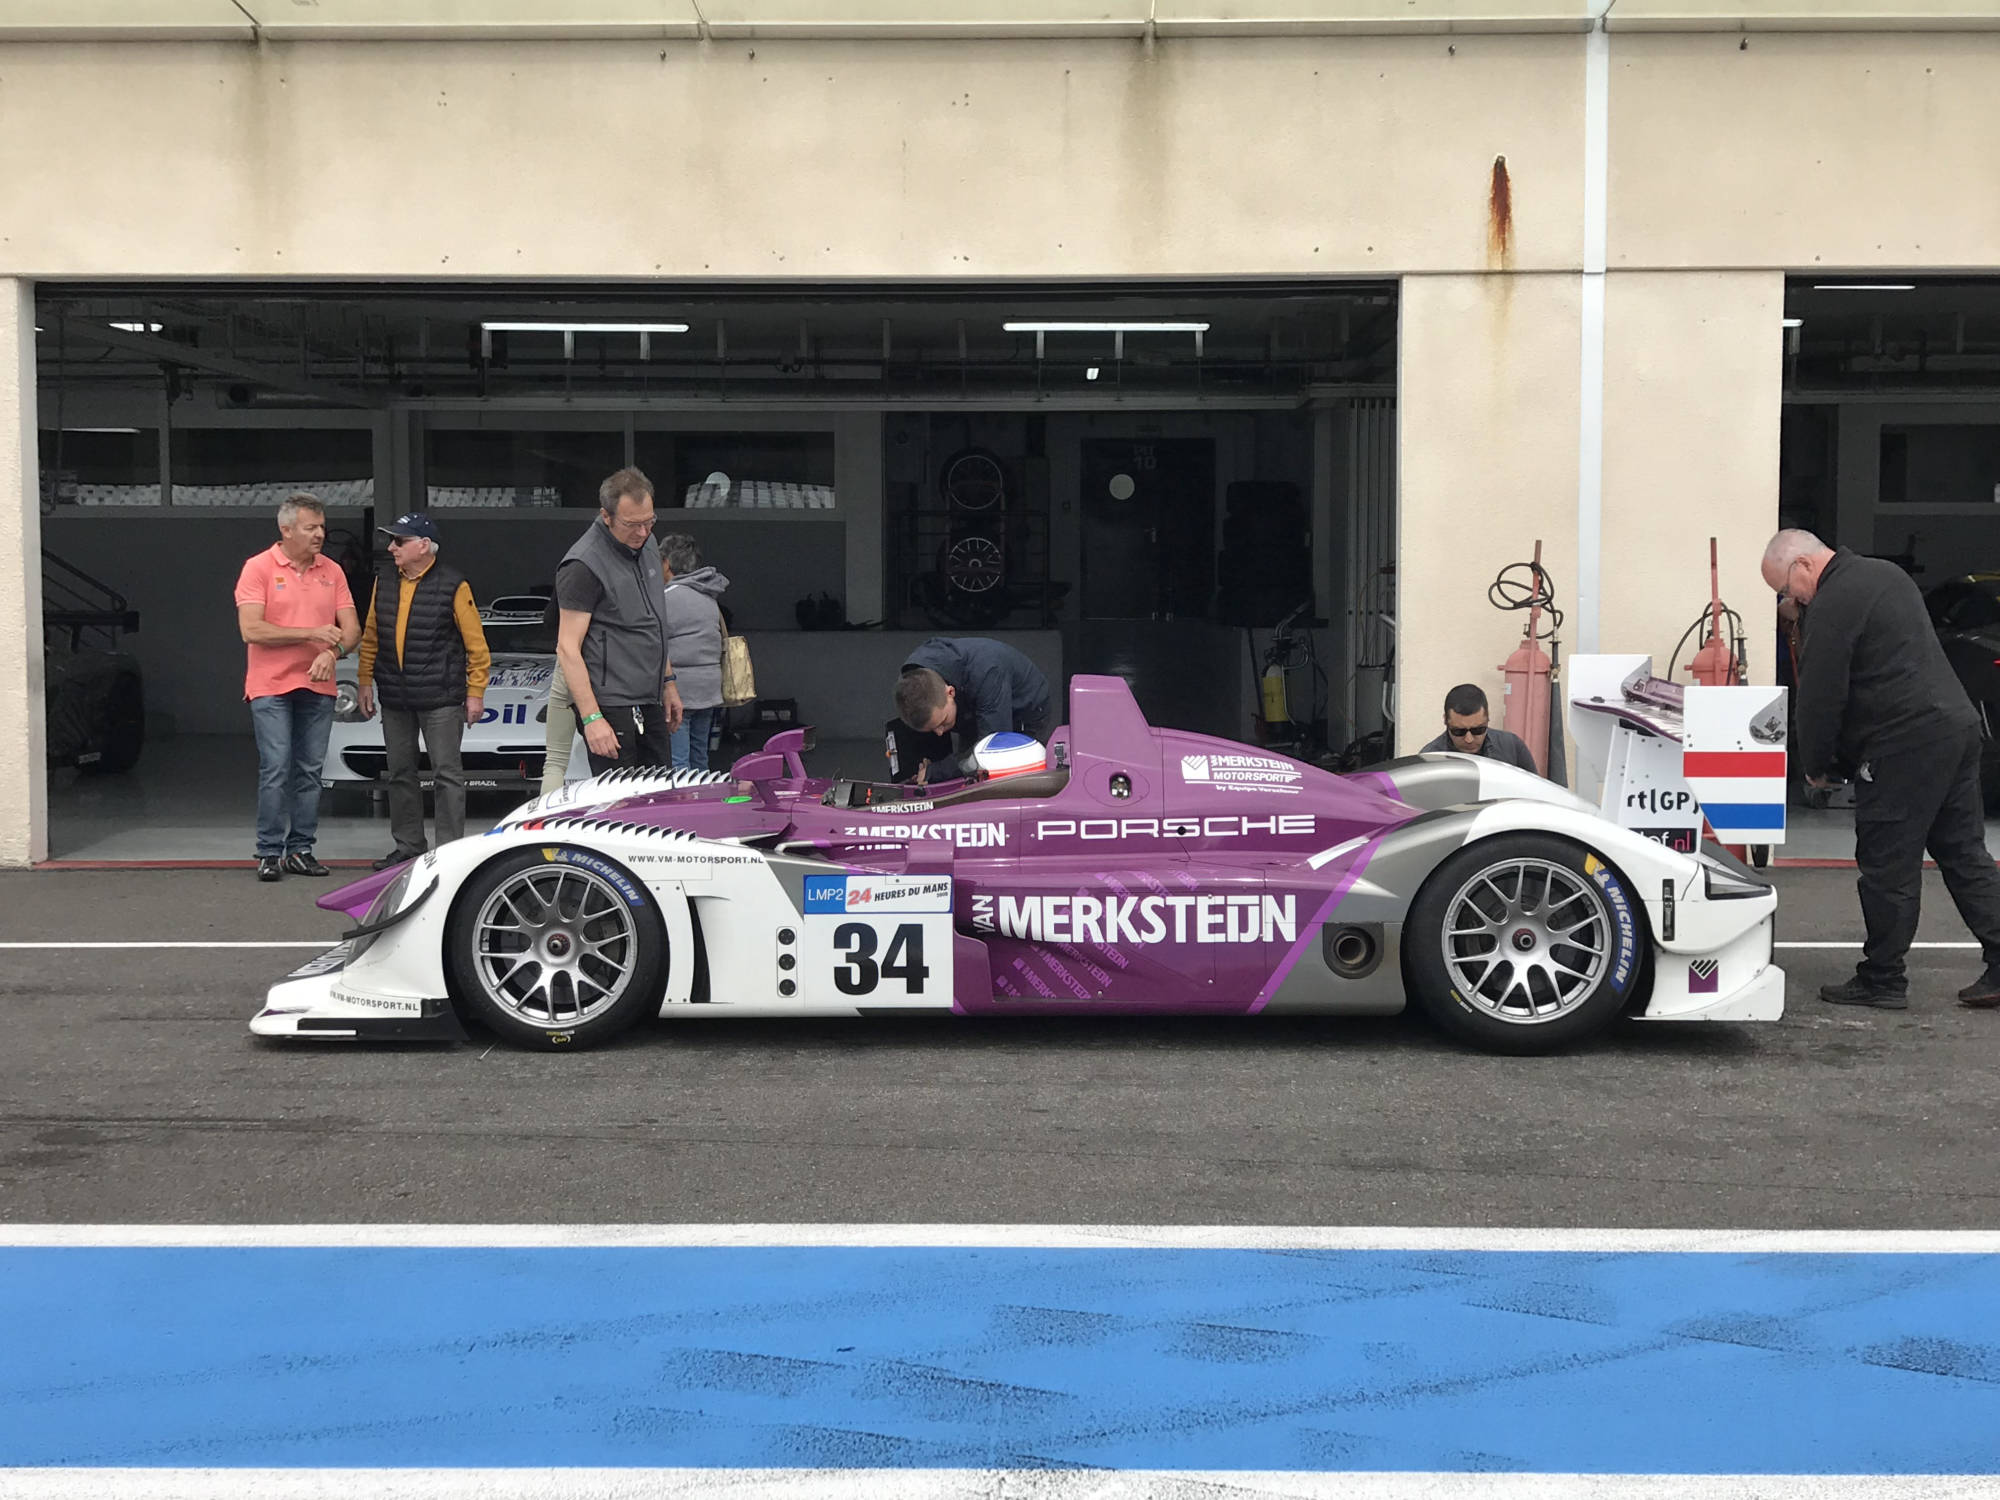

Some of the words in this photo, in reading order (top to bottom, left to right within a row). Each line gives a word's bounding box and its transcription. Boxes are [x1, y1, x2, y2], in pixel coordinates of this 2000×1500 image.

[1037, 814, 1316, 841] PORSCHE
[572, 853, 640, 902] MICHELIN
[628, 855, 765, 864] WWW.VM-MOTORSPORT.NL
[808, 888, 844, 901] LMP2
[847, 888, 872, 906] 24
[874, 888, 906, 902] HEURES
[908, 886, 920, 896] DU
[922, 882, 949, 895] MANS
[972, 895, 994, 933] VAN
[998, 894, 1296, 943] MERKSTEIJN
[1607, 886, 1633, 984] MICHELIN
[833, 922, 930, 996] 34
